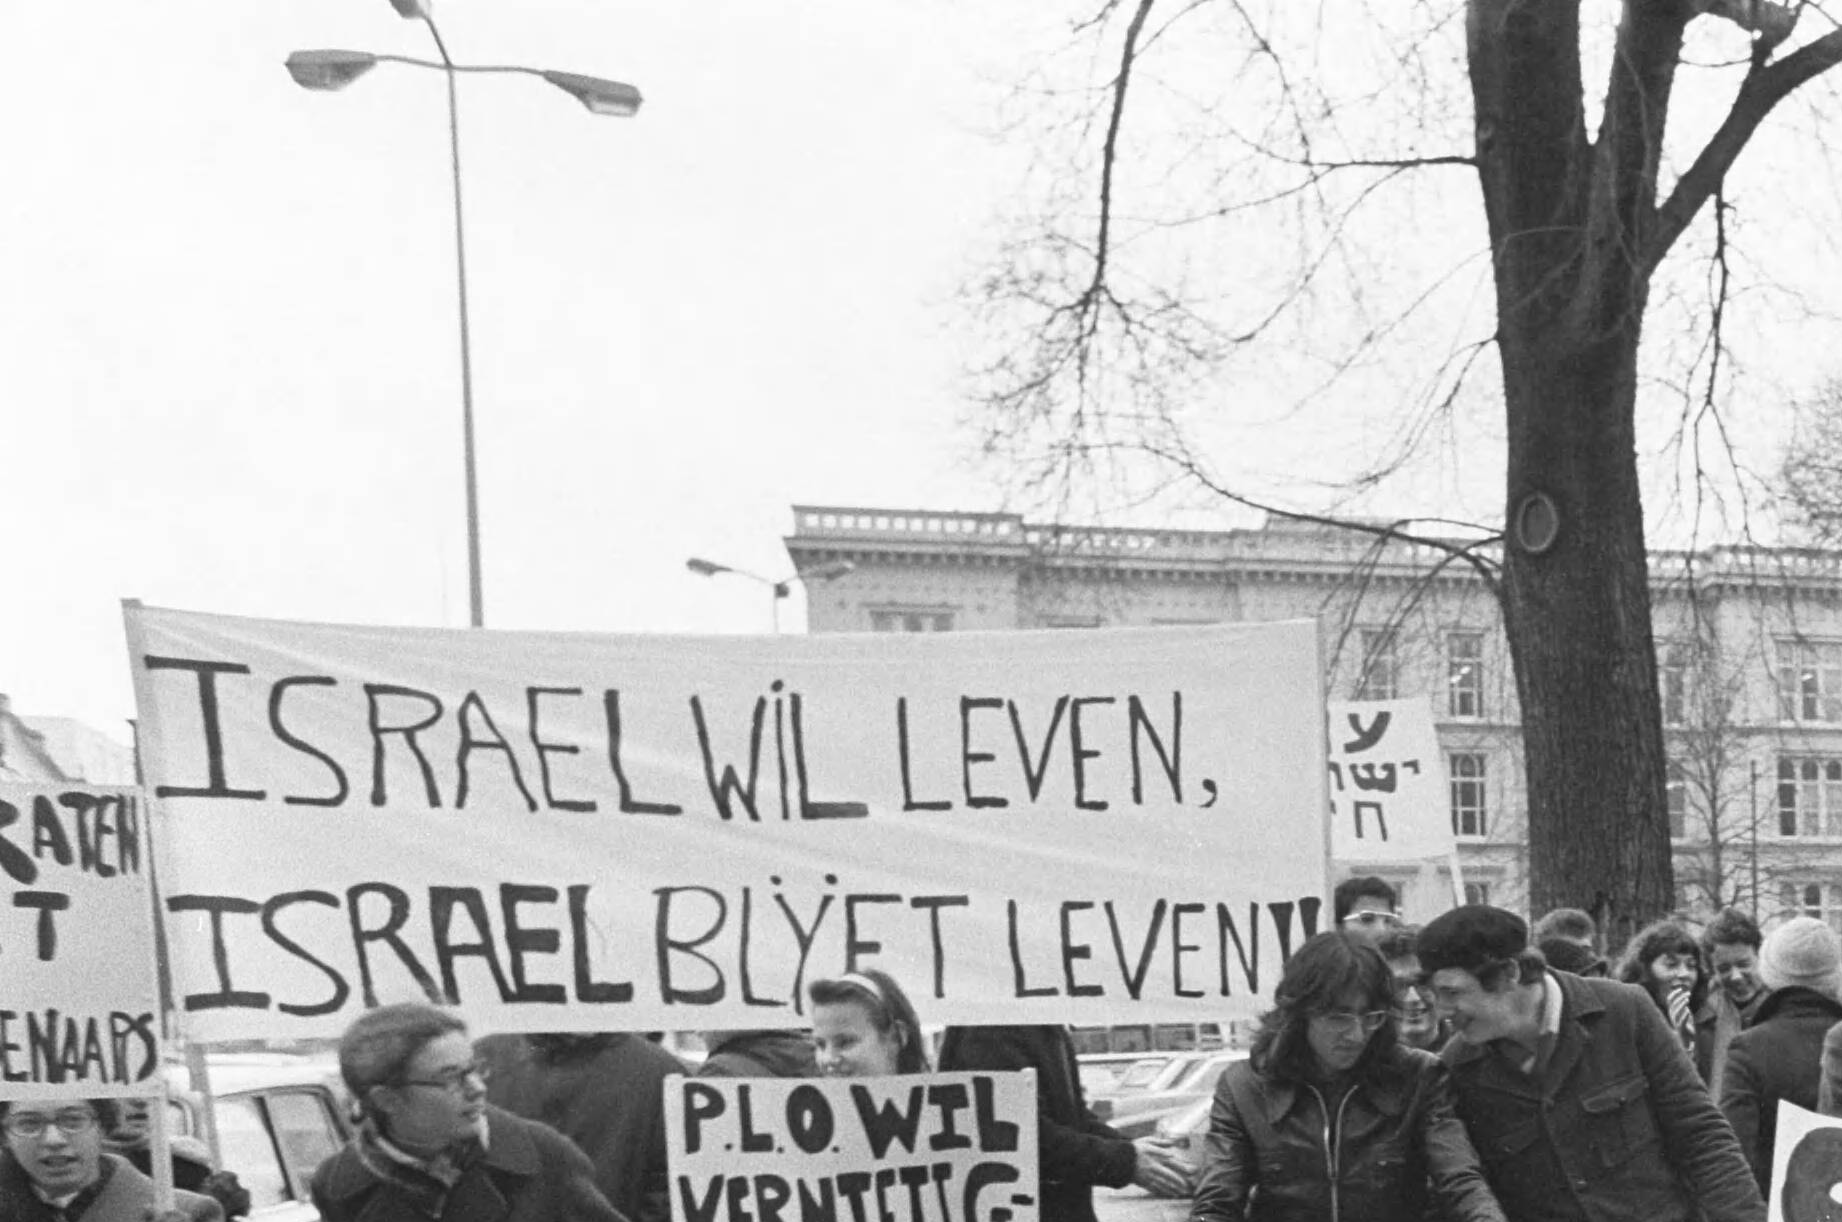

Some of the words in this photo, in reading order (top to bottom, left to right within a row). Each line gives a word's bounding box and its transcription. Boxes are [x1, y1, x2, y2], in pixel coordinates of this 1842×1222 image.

[144, 656, 683, 814] ISRAEL
[897, 691, 1217, 811] LEVEN,
[167, 882, 633, 1016] ISRAEL
[684, 1082, 840, 1154] P.L.O.
[850, 1076, 1020, 1160] WIL
